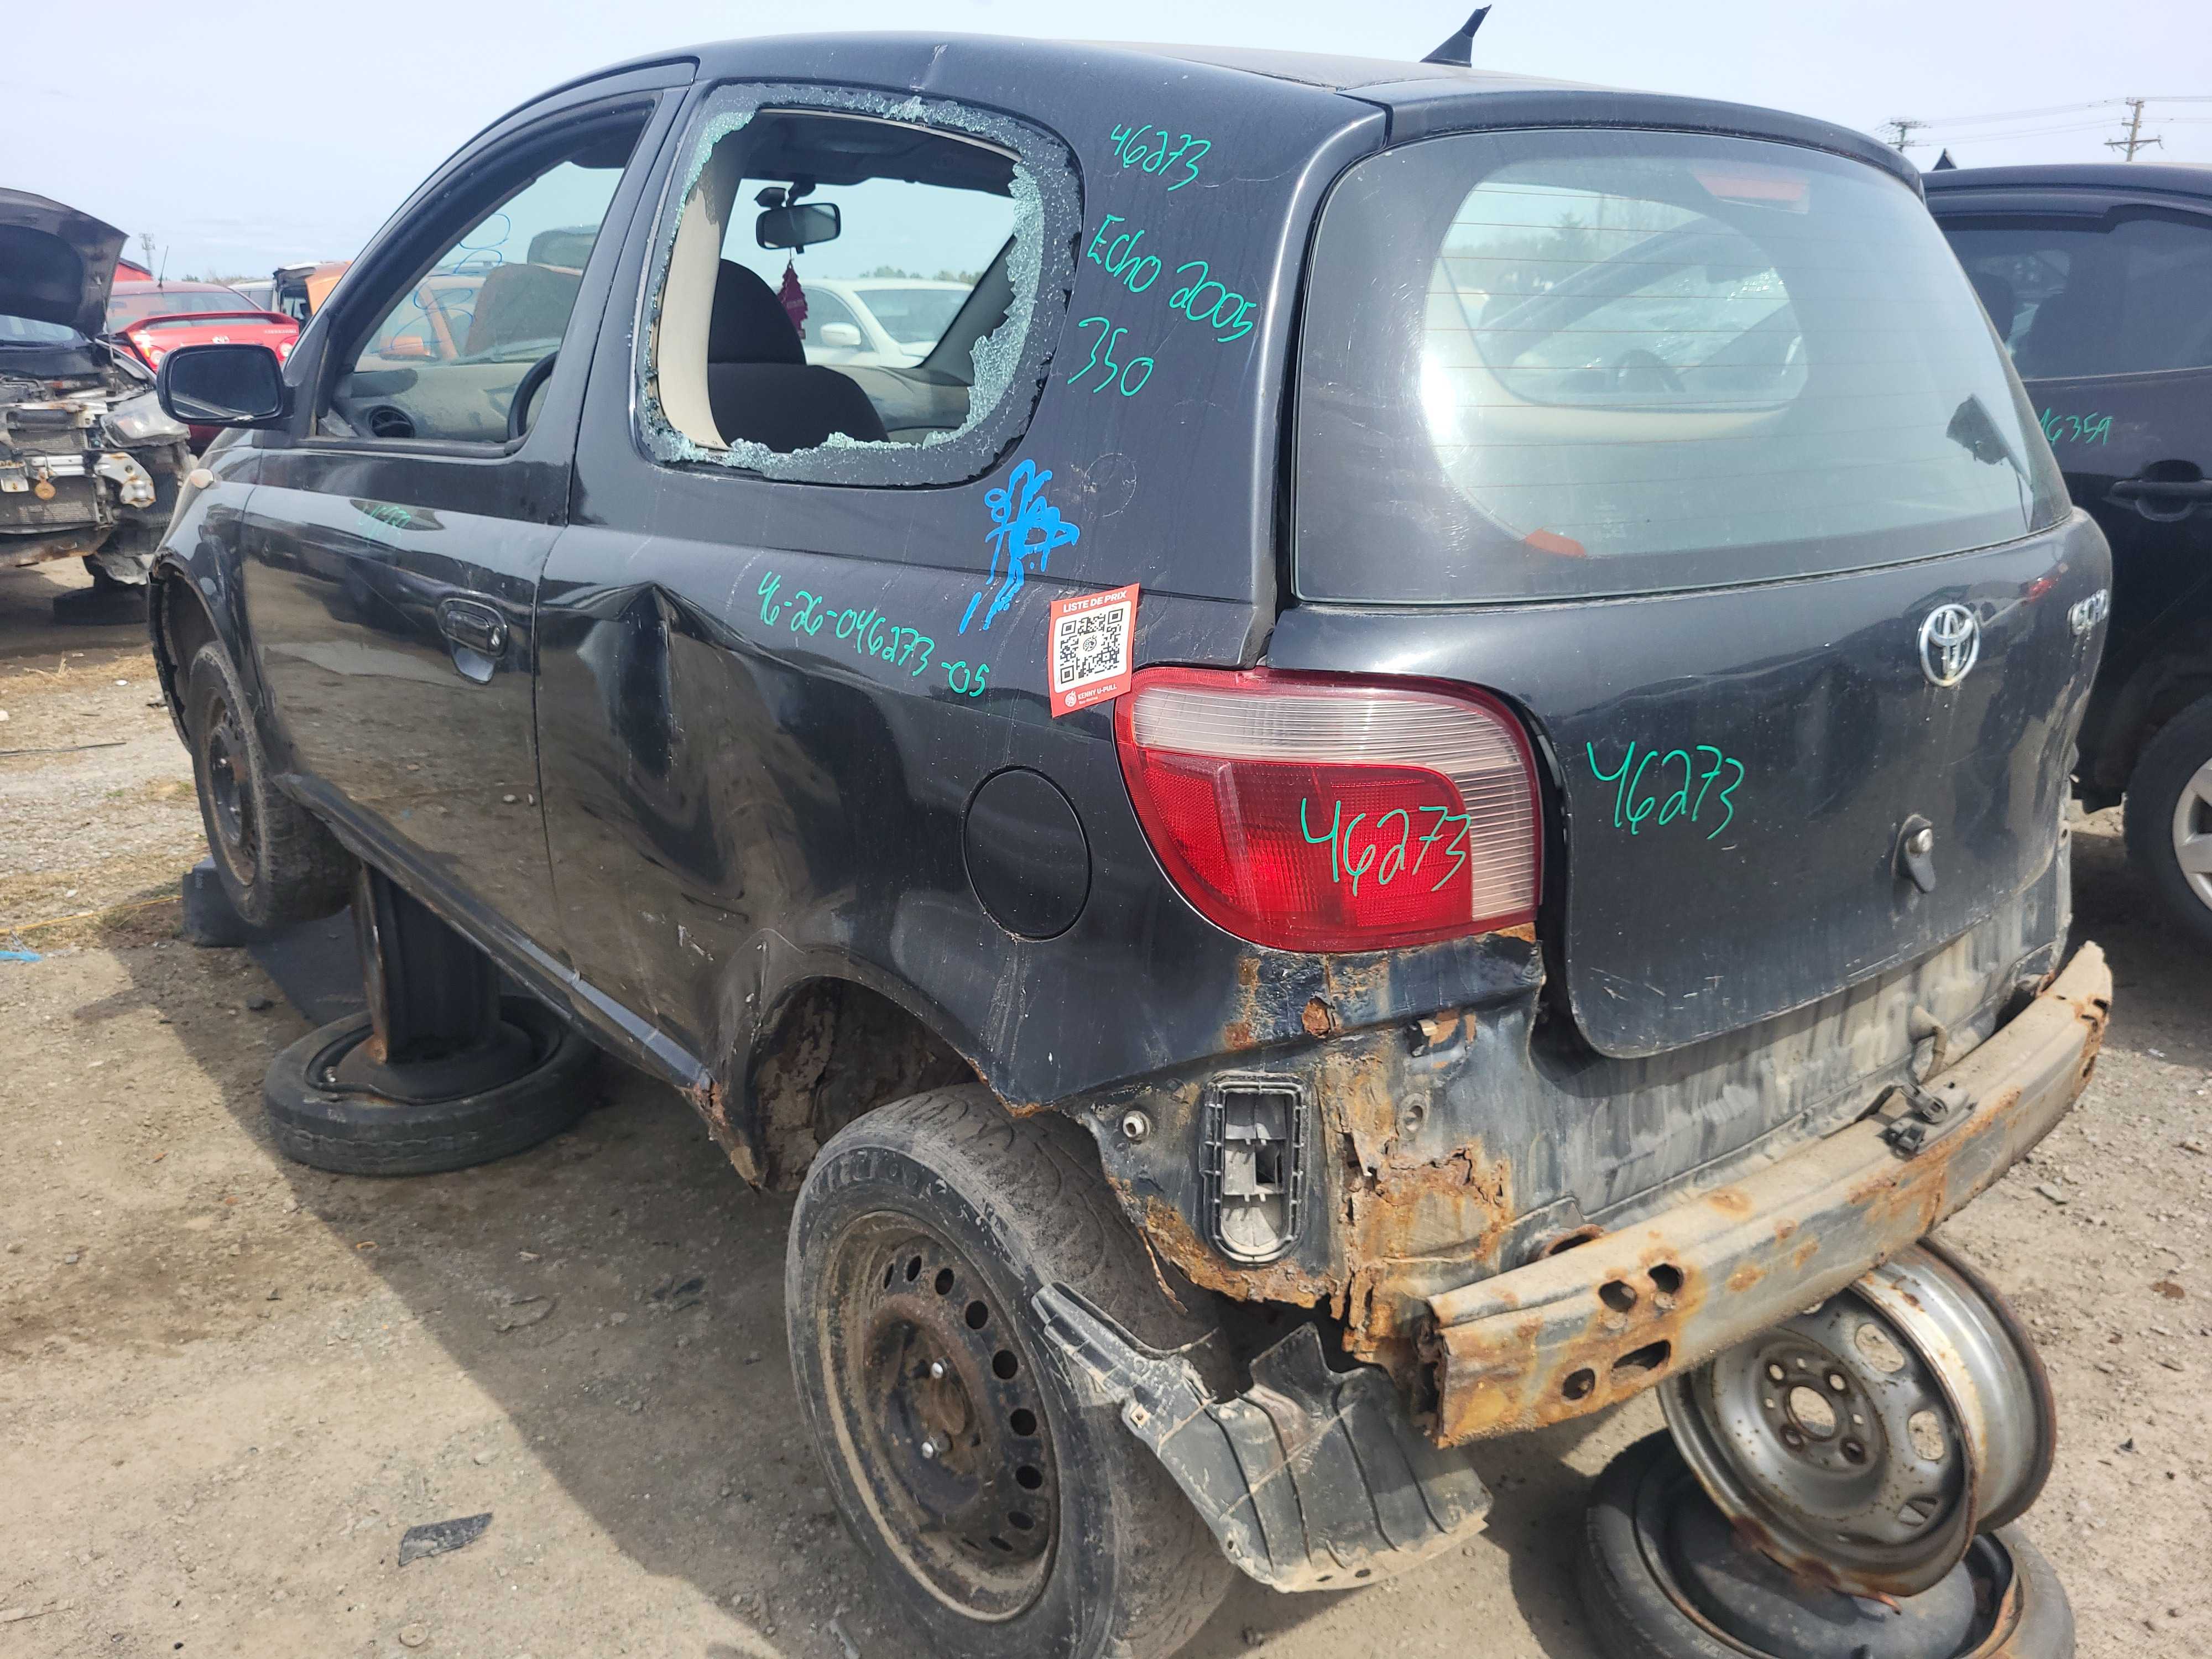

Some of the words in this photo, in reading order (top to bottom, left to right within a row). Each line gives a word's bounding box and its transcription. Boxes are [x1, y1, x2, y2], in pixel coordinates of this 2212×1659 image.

[1110, 124, 1211, 191] 46273
[1169, 261, 1257, 342] 2005
[1067, 317, 1154, 397] 350
[1063, 599, 1089, 613] LISTE
[1090, 596, 1104, 607] DE
[1104, 590, 1127, 603] PRIX
[1077, 688, 1096, 700] KENNY
[1097, 684, 1117, 695] U-PULL
[1587, 741, 1745, 840] 46273
[1301, 798, 1471, 896] 46273
